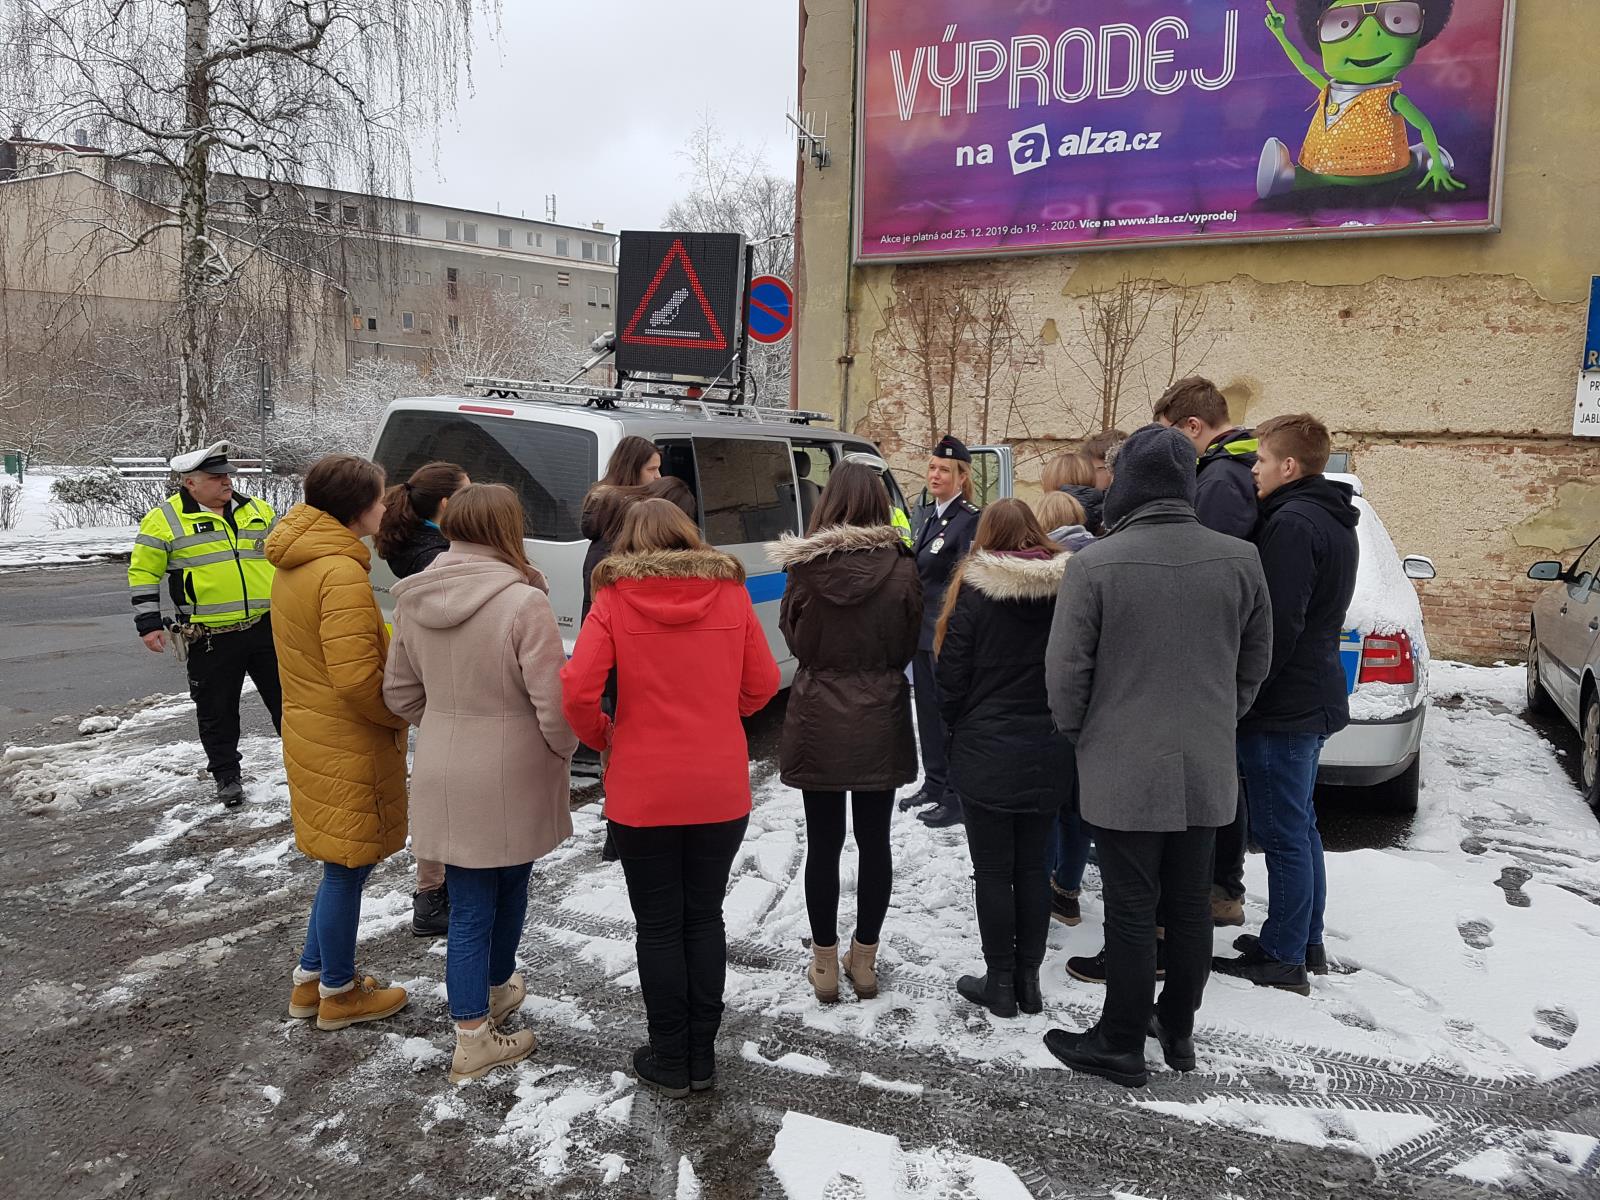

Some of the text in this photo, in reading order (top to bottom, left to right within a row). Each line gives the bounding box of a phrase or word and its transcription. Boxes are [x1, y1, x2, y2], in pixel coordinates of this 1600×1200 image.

[889, 9, 1239, 121] VÝPRODEJ
[956, 143, 993, 167] na
[1058, 126, 1162, 157] alza.cz
[880, 234, 901, 244] Akce
[902, 234, 911, 245] je
[912, 230, 939, 244] platná
[940, 230, 953, 240] od
[955, 229, 968, 239] 25.
[971, 227, 984, 238] 12.
[986, 226, 1008, 237] 2019
[1010, 225, 1023, 235] do
[1026, 223, 1039, 233] 19.
[1051, 220, 1077, 231] 2020.
[1079, 218, 1101, 229] Více
[1103, 219, 1116, 228] na
[1118, 210, 1237, 227] www.alza.cz/vyprodej
